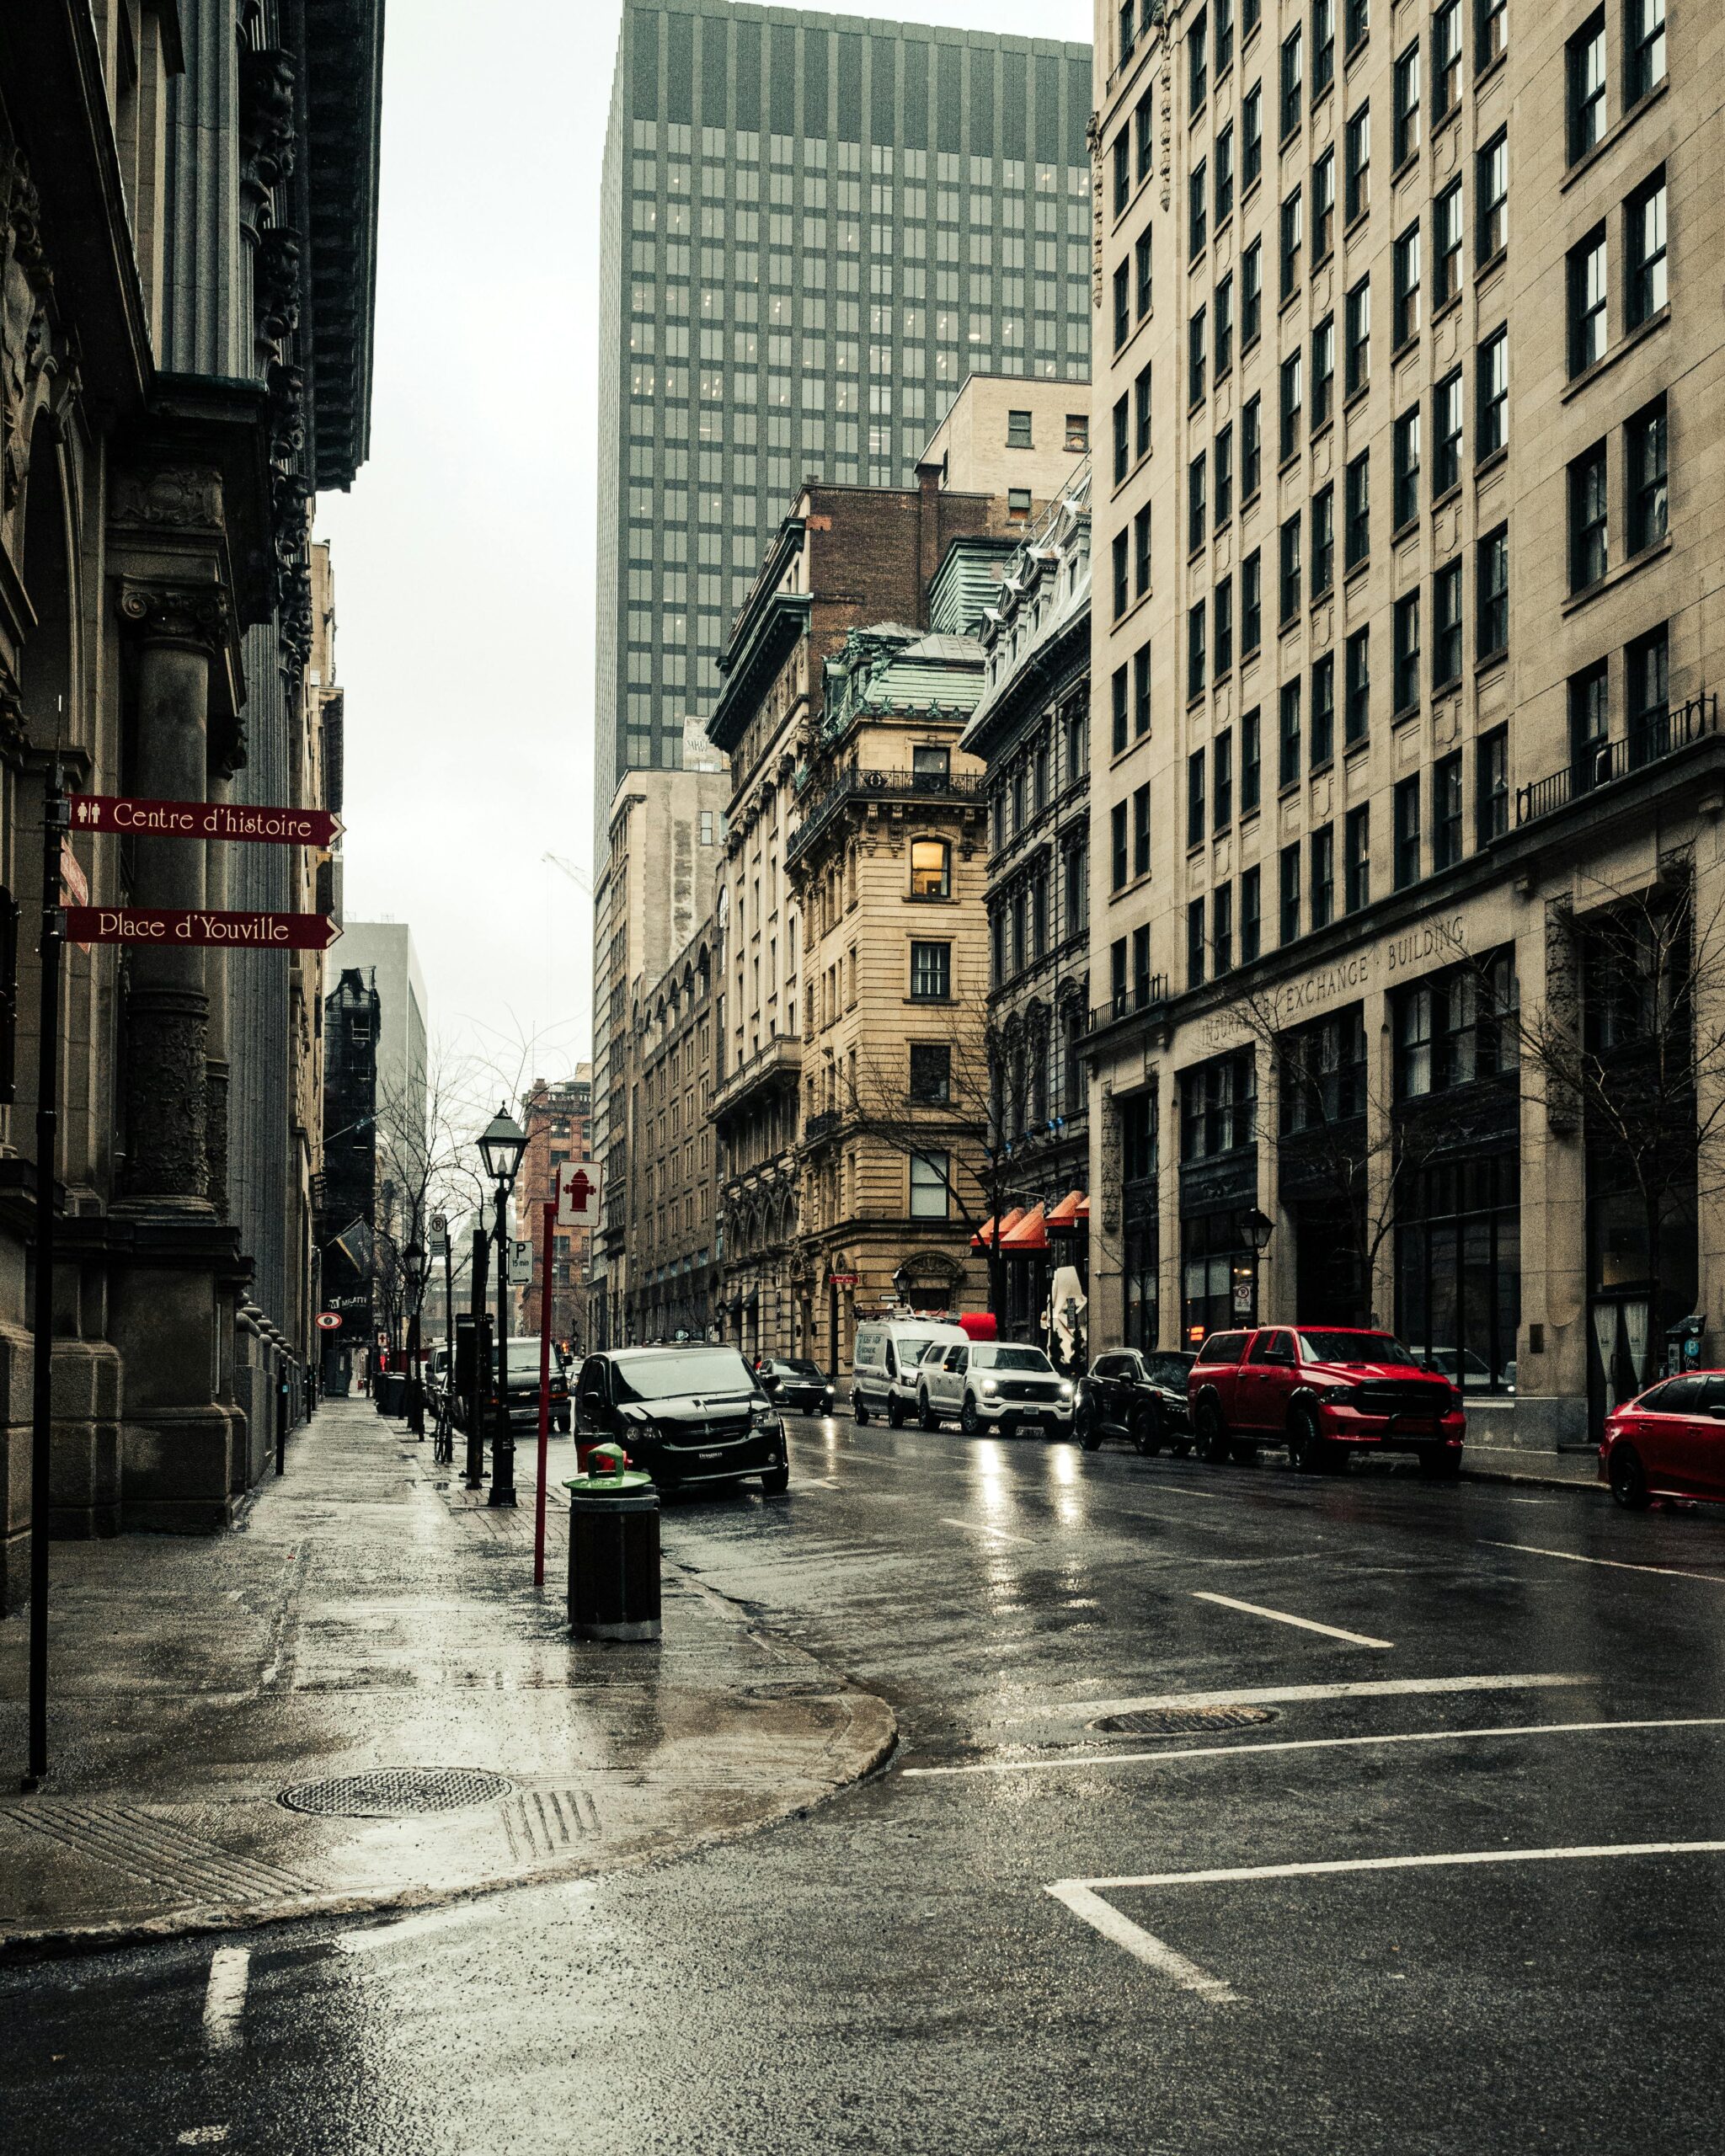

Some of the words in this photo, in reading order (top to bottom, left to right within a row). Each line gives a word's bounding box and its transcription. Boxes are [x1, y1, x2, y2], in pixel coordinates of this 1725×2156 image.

[114, 803, 194, 830] Centre
[204, 808, 312, 837] d'histoire
[99, 912, 165, 937] Place
[175, 914, 289, 941] d'Youville
[1286, 956, 1369, 1012] EXCHANGE
[1388, 916, 1464, 970] BUILDING
[516, 1243, 526, 1259] P
